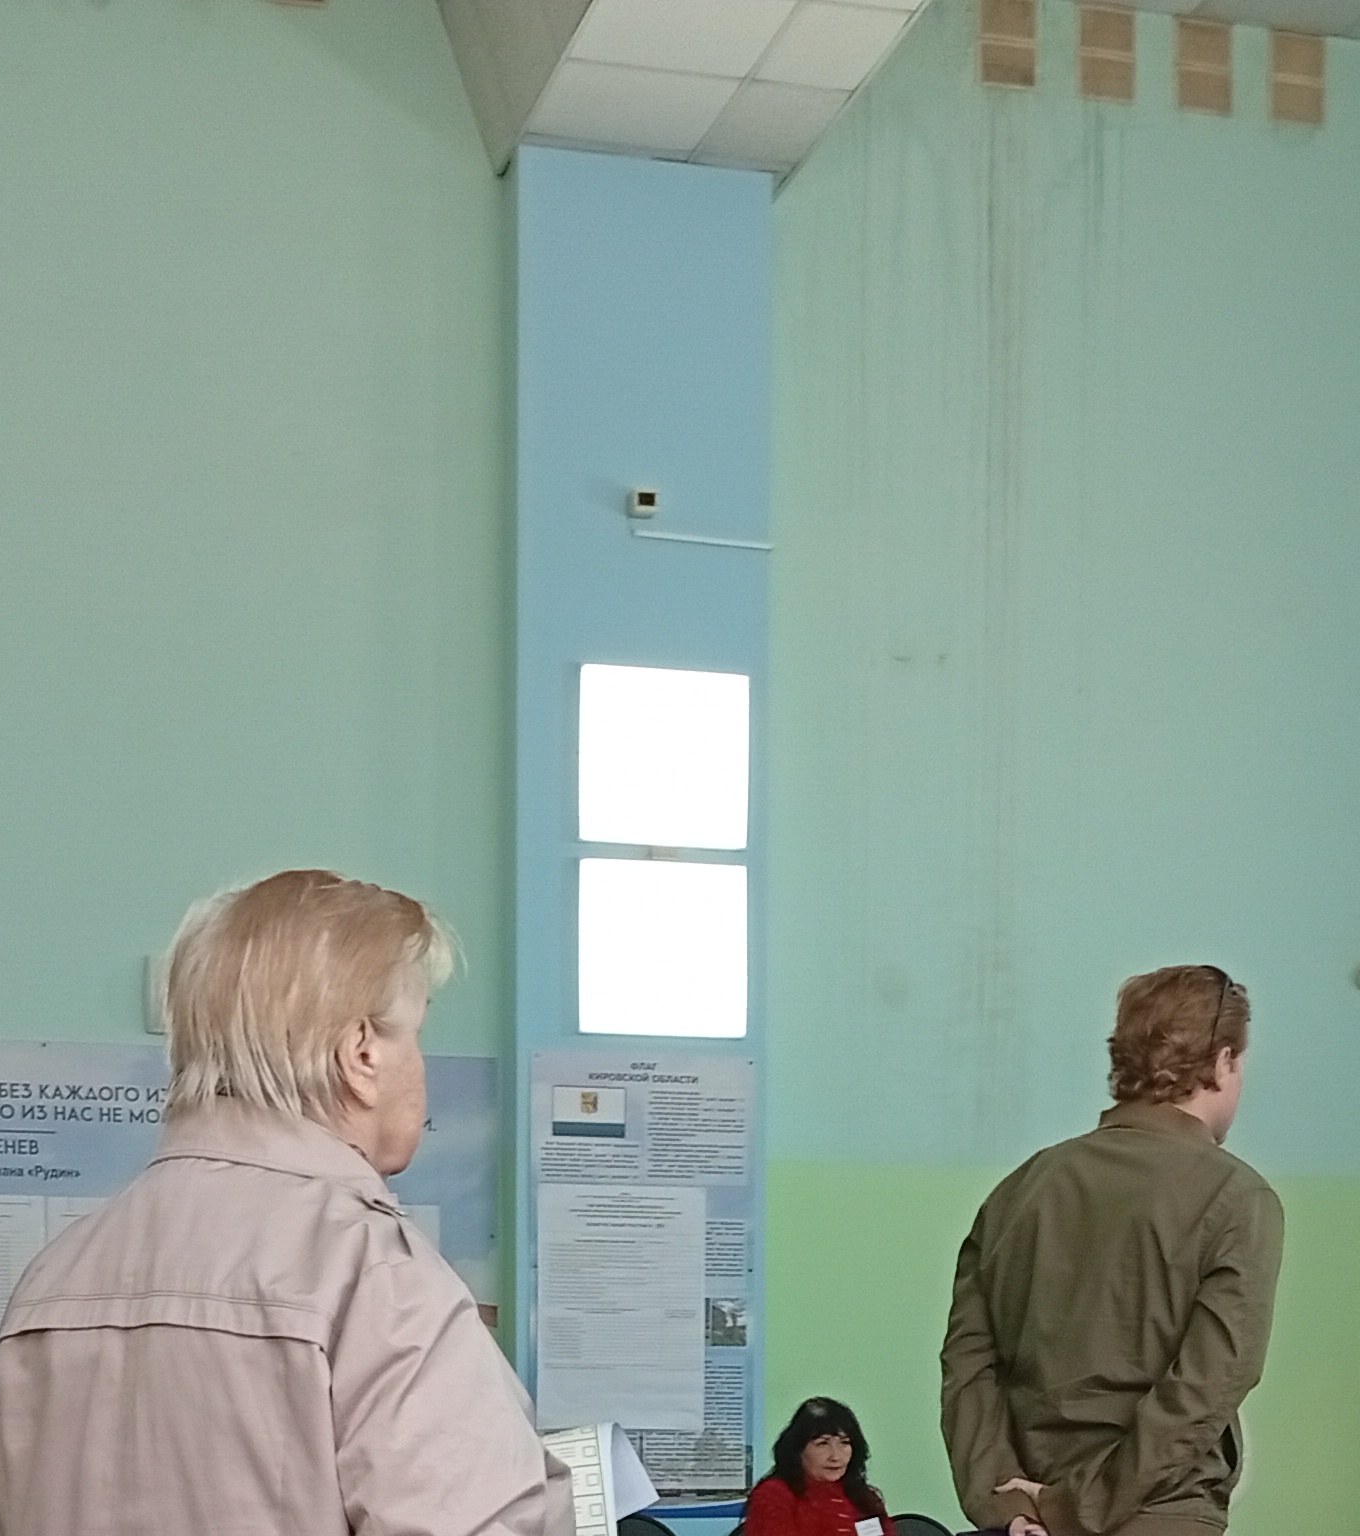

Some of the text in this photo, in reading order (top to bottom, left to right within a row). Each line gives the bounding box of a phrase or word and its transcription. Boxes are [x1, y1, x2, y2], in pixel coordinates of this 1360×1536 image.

[630, 1062, 658, 1071] ФЛАГ
[588, 1072, 699, 1084] КИРОВСКОЙ ОБЛАСТИ
[39, 1084, 140, 1102] КАЖДОГО
[21, 1104, 48, 1120] ИЗ
[54, 1106, 93, 1122] НАС
[99, 1107, 123, 1123] НЕ
[129, 1108, 166, 1124] МО
[27, 1166, 81, 1180] «Рудин»
